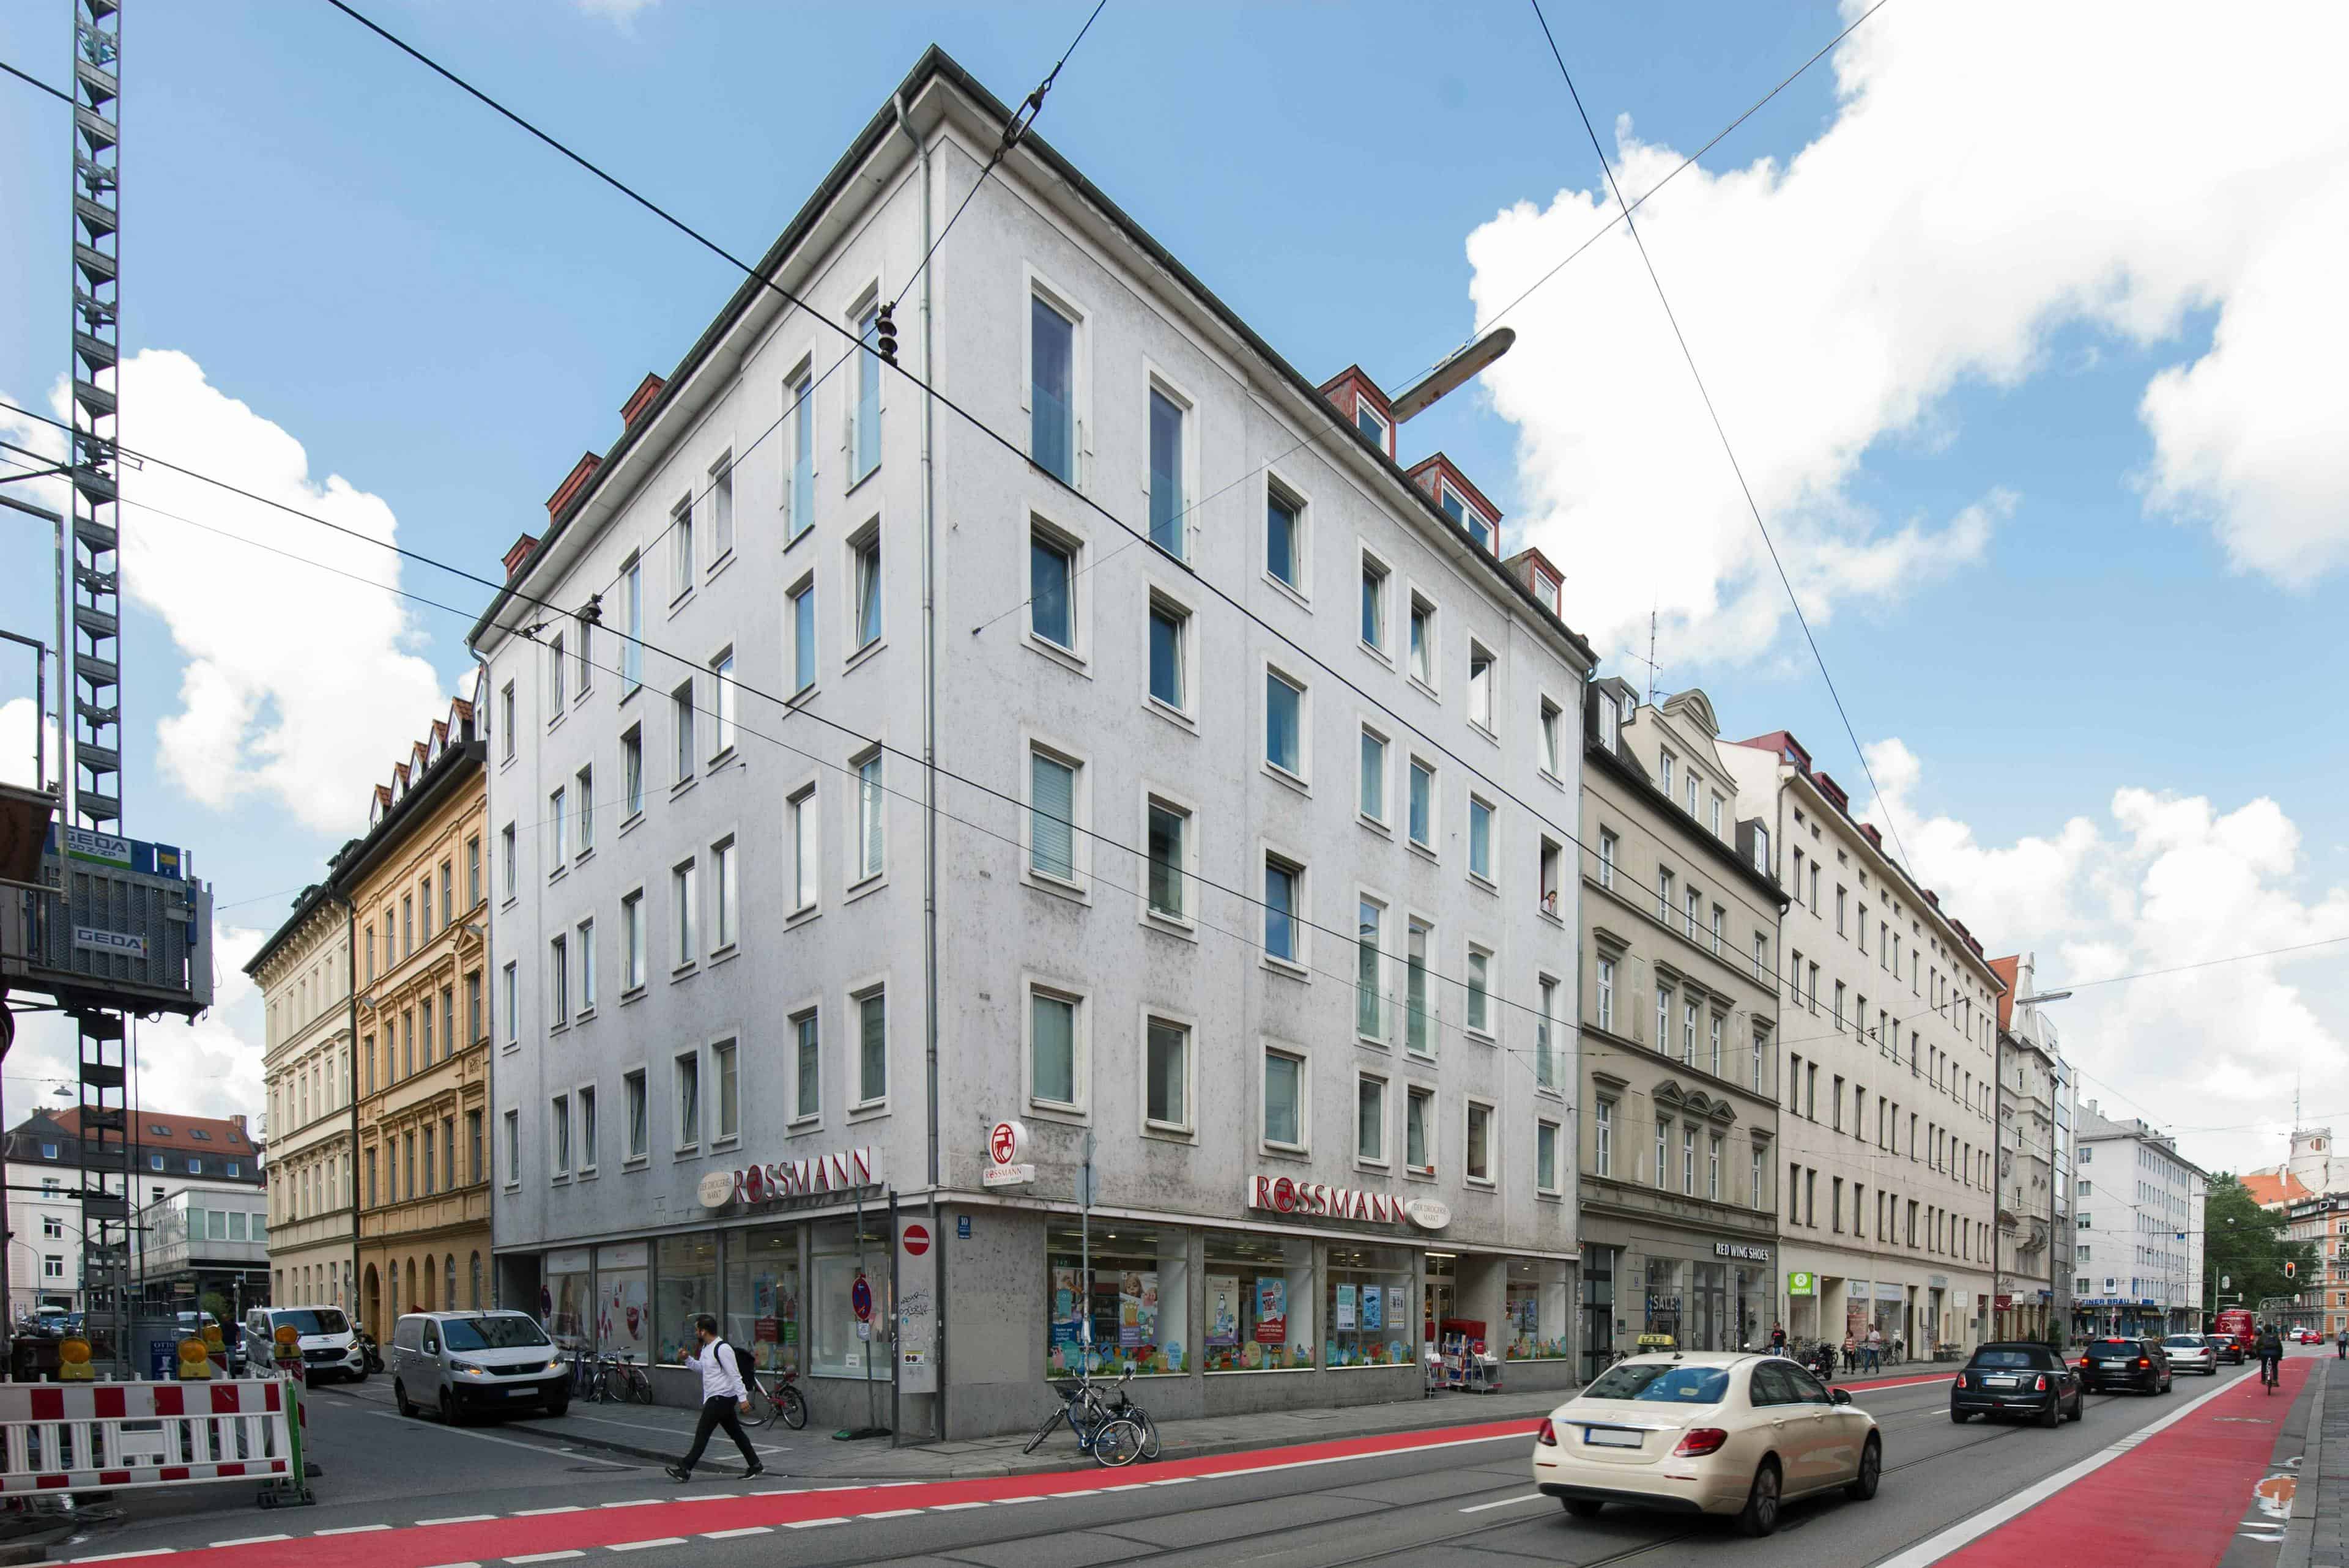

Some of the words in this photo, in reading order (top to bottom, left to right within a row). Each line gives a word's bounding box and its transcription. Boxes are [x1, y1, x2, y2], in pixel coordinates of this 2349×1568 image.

[78, 930, 141, 950] GEDA
[734, 1145, 870, 1204] ROSSMANN
[985, 1167, 1022, 1179] ROSSMANN
[1256, 1175, 1405, 1222] ROSSMANN
[1716, 1243, 1729, 1256] RED
[1731, 1245, 1748, 1258] WING
[1749, 1248, 1768, 1260] SHOES
[1653, 1295, 1675, 1310] SALE
